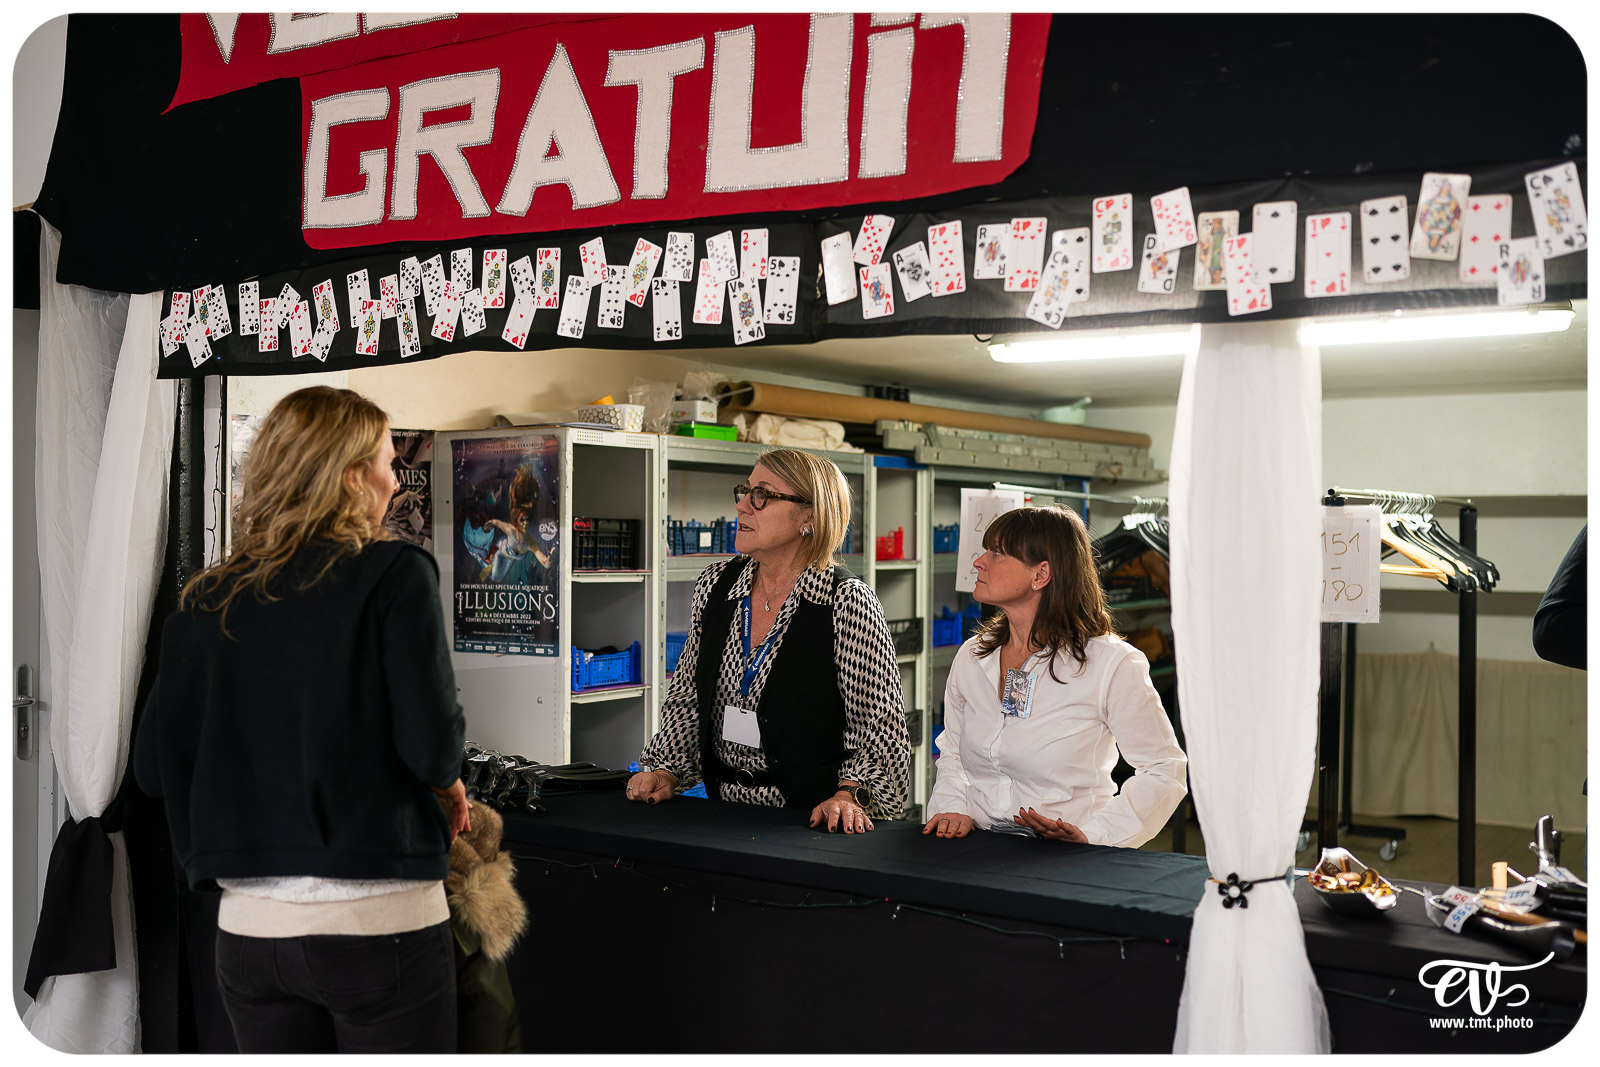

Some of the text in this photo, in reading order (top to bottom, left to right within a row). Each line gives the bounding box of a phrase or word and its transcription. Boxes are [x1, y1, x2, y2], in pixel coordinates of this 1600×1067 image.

[1530, 177, 1541, 190] C
[1096, 201, 1103, 212] C
[1154, 199, 1162, 210] 9
[1013, 221, 1020, 232] 4
[1311, 219, 1316, 231] 1
[743, 232, 749, 243] 2
[930, 229, 936, 240] 7
[979, 228, 987, 239] R
[670, 234, 677, 245] 10
[1147, 237, 1155, 249] D
[637, 240, 644, 251] D
[708, 240, 714, 251] 9
[1226, 240, 1234, 253] 7
[1500, 244, 1509, 258] R
[485, 251, 490, 261] C
[539, 250, 544, 260] V
[581, 246, 587, 257] 3
[452, 253, 457, 262] 8
[871, 254, 879, 265] 8
[896, 254, 903, 265] A
[1053, 252, 1062, 263] C
[1121, 255, 1129, 266] C
[401, 261, 406, 270] 8
[421, 263, 427, 273] 10
[511, 265, 516, 275] 6
[770, 259, 776, 270] 5
[998, 264, 1005, 275] R
[601, 270, 607, 280] 3
[683, 269, 690, 279] 10
[730, 266, 736, 276] 9
[760, 266, 766, 277] 2
[862, 269, 869, 280] V
[349, 276, 353, 285] 3
[381, 280, 386, 289] 10
[466, 280, 471, 289] 8
[569, 278, 574, 287] 4
[654, 280, 659, 290] 2
[956, 279, 963, 290] 7
[1031, 277, 1038, 288] 4
[1163, 279, 1172, 290] D
[1341, 280, 1346, 292] 1
[240, 285, 244, 294] 6
[283, 285, 290, 294] 3
[414, 286, 419, 294] 8
[444, 283, 450, 292] 5
[730, 281, 737, 292] V
[173, 293, 177, 302] 8
[194, 290, 198, 299] V
[314, 288, 319, 297] R
[1532, 286, 1541, 299] R
[460, 296, 465, 306] 7
[498, 297, 503, 306] C
[552, 297, 557, 307] V
[637, 294, 644, 305] D
[1260, 295, 1268, 307] 7
[362, 301, 367, 310] D
[397, 304, 401, 313] R
[885, 302, 892, 313] V
[617, 316, 622, 326] 8
[787, 311, 793, 322] 5
[1050, 312, 1060, 324] C
[255, 323, 259, 332] 6
[320, 319, 325, 327] 4
[447, 330, 453, 340] 5
[576, 326, 582, 336] 4
[674, 327, 679, 337] 2
[756, 326, 763, 337] V
[273, 340, 277, 349] 8
[372, 344, 377, 354] D
[414, 342, 419, 352] R
[393, 469, 427, 486] MES
[1321, 532, 1360, 556] 151
[1322, 580, 1362, 604] 180
[455, 592, 555, 619] ILLUSIONS
